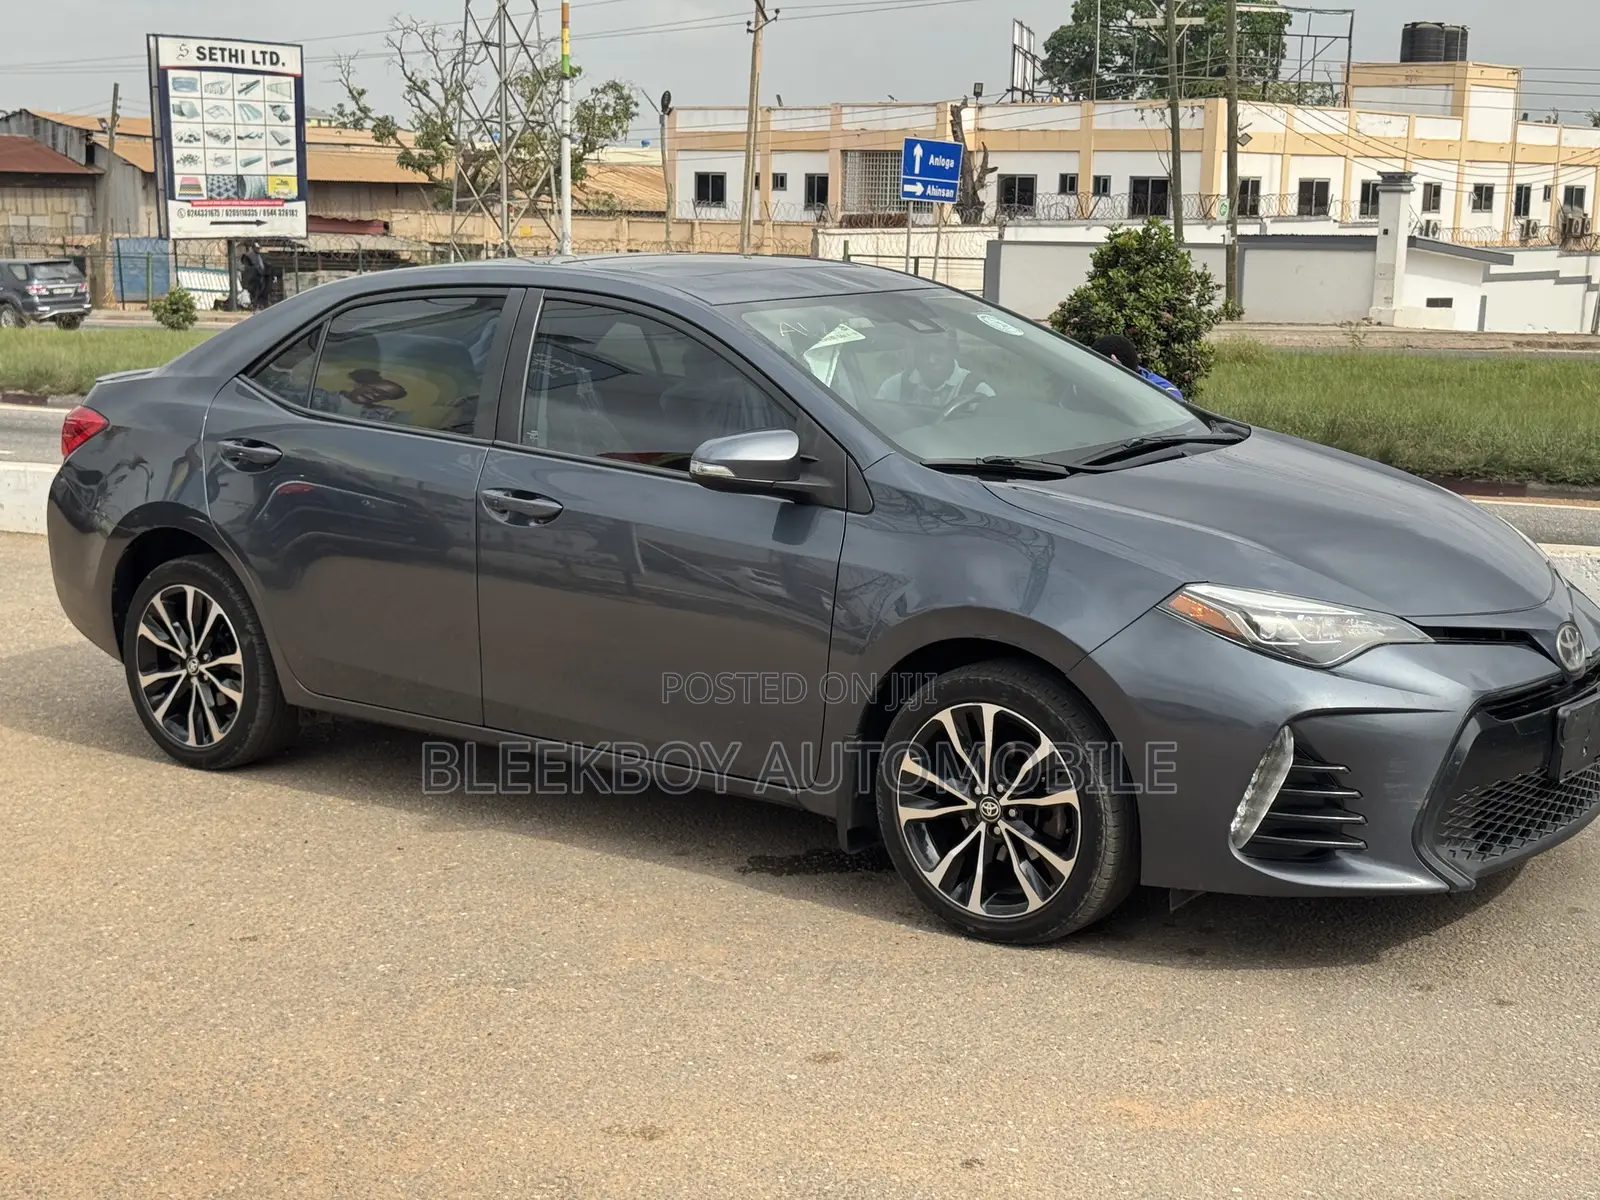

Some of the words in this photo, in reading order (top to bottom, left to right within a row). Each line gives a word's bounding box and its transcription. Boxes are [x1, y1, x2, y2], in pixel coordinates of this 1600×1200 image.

[196, 46, 245, 64] SETHI
[251, 50, 286, 67] LTD.
[928, 154, 955, 170] Anloga
[925, 185, 954, 198] Ahinsan
